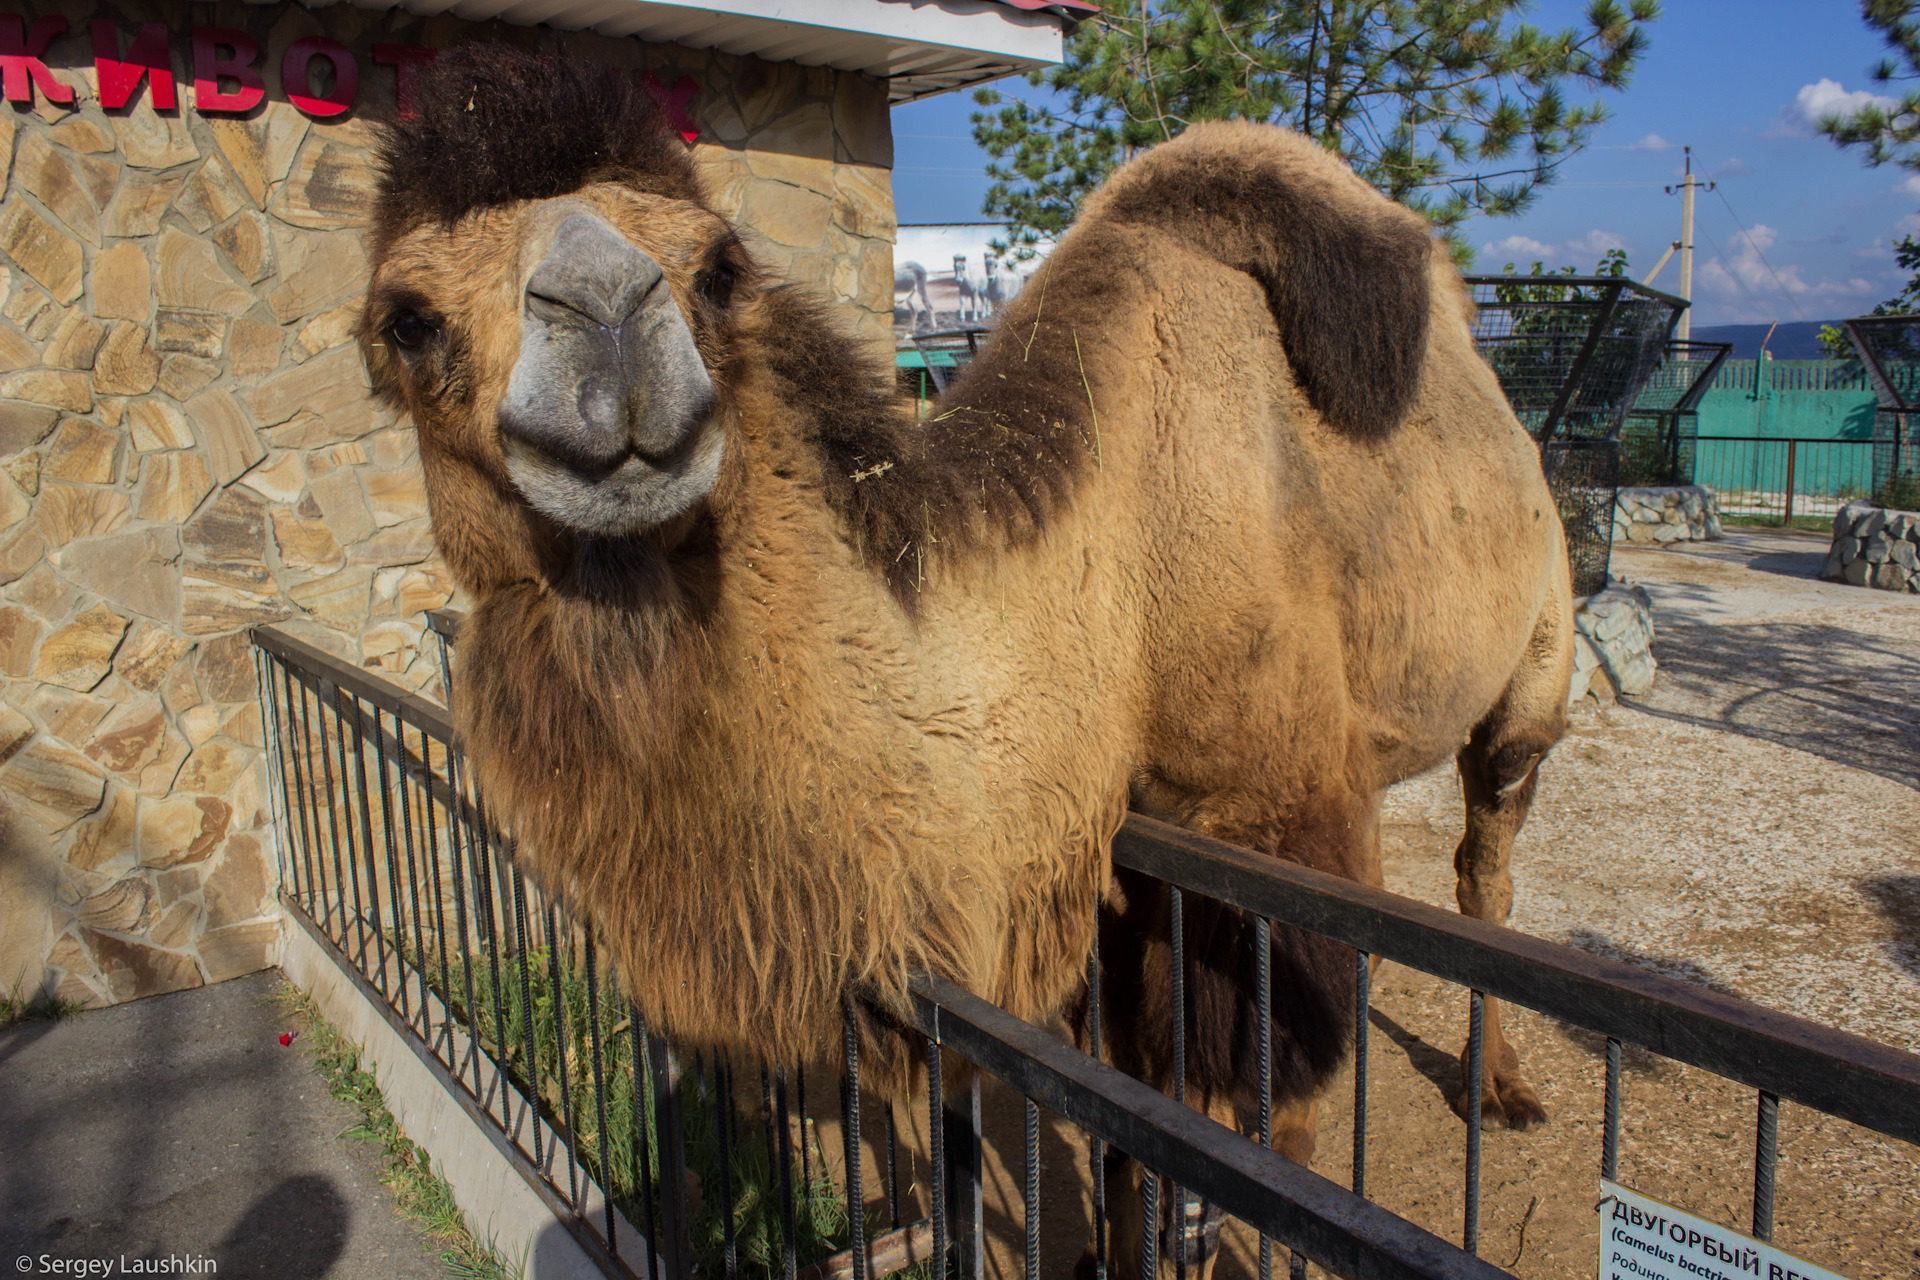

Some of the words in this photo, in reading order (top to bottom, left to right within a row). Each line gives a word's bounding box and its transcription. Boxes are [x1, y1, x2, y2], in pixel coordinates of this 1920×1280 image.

[0, 13, 701, 142] ЖИВОТХ
[1611, 1226, 1675, 1263] (Camelus
[1611, 1251, 1669, 1280] Родина
[1612, 1200, 1759, 1276] ДВУГОРБЫЙ
[1769, 1262, 1811, 1280] ВЕ
